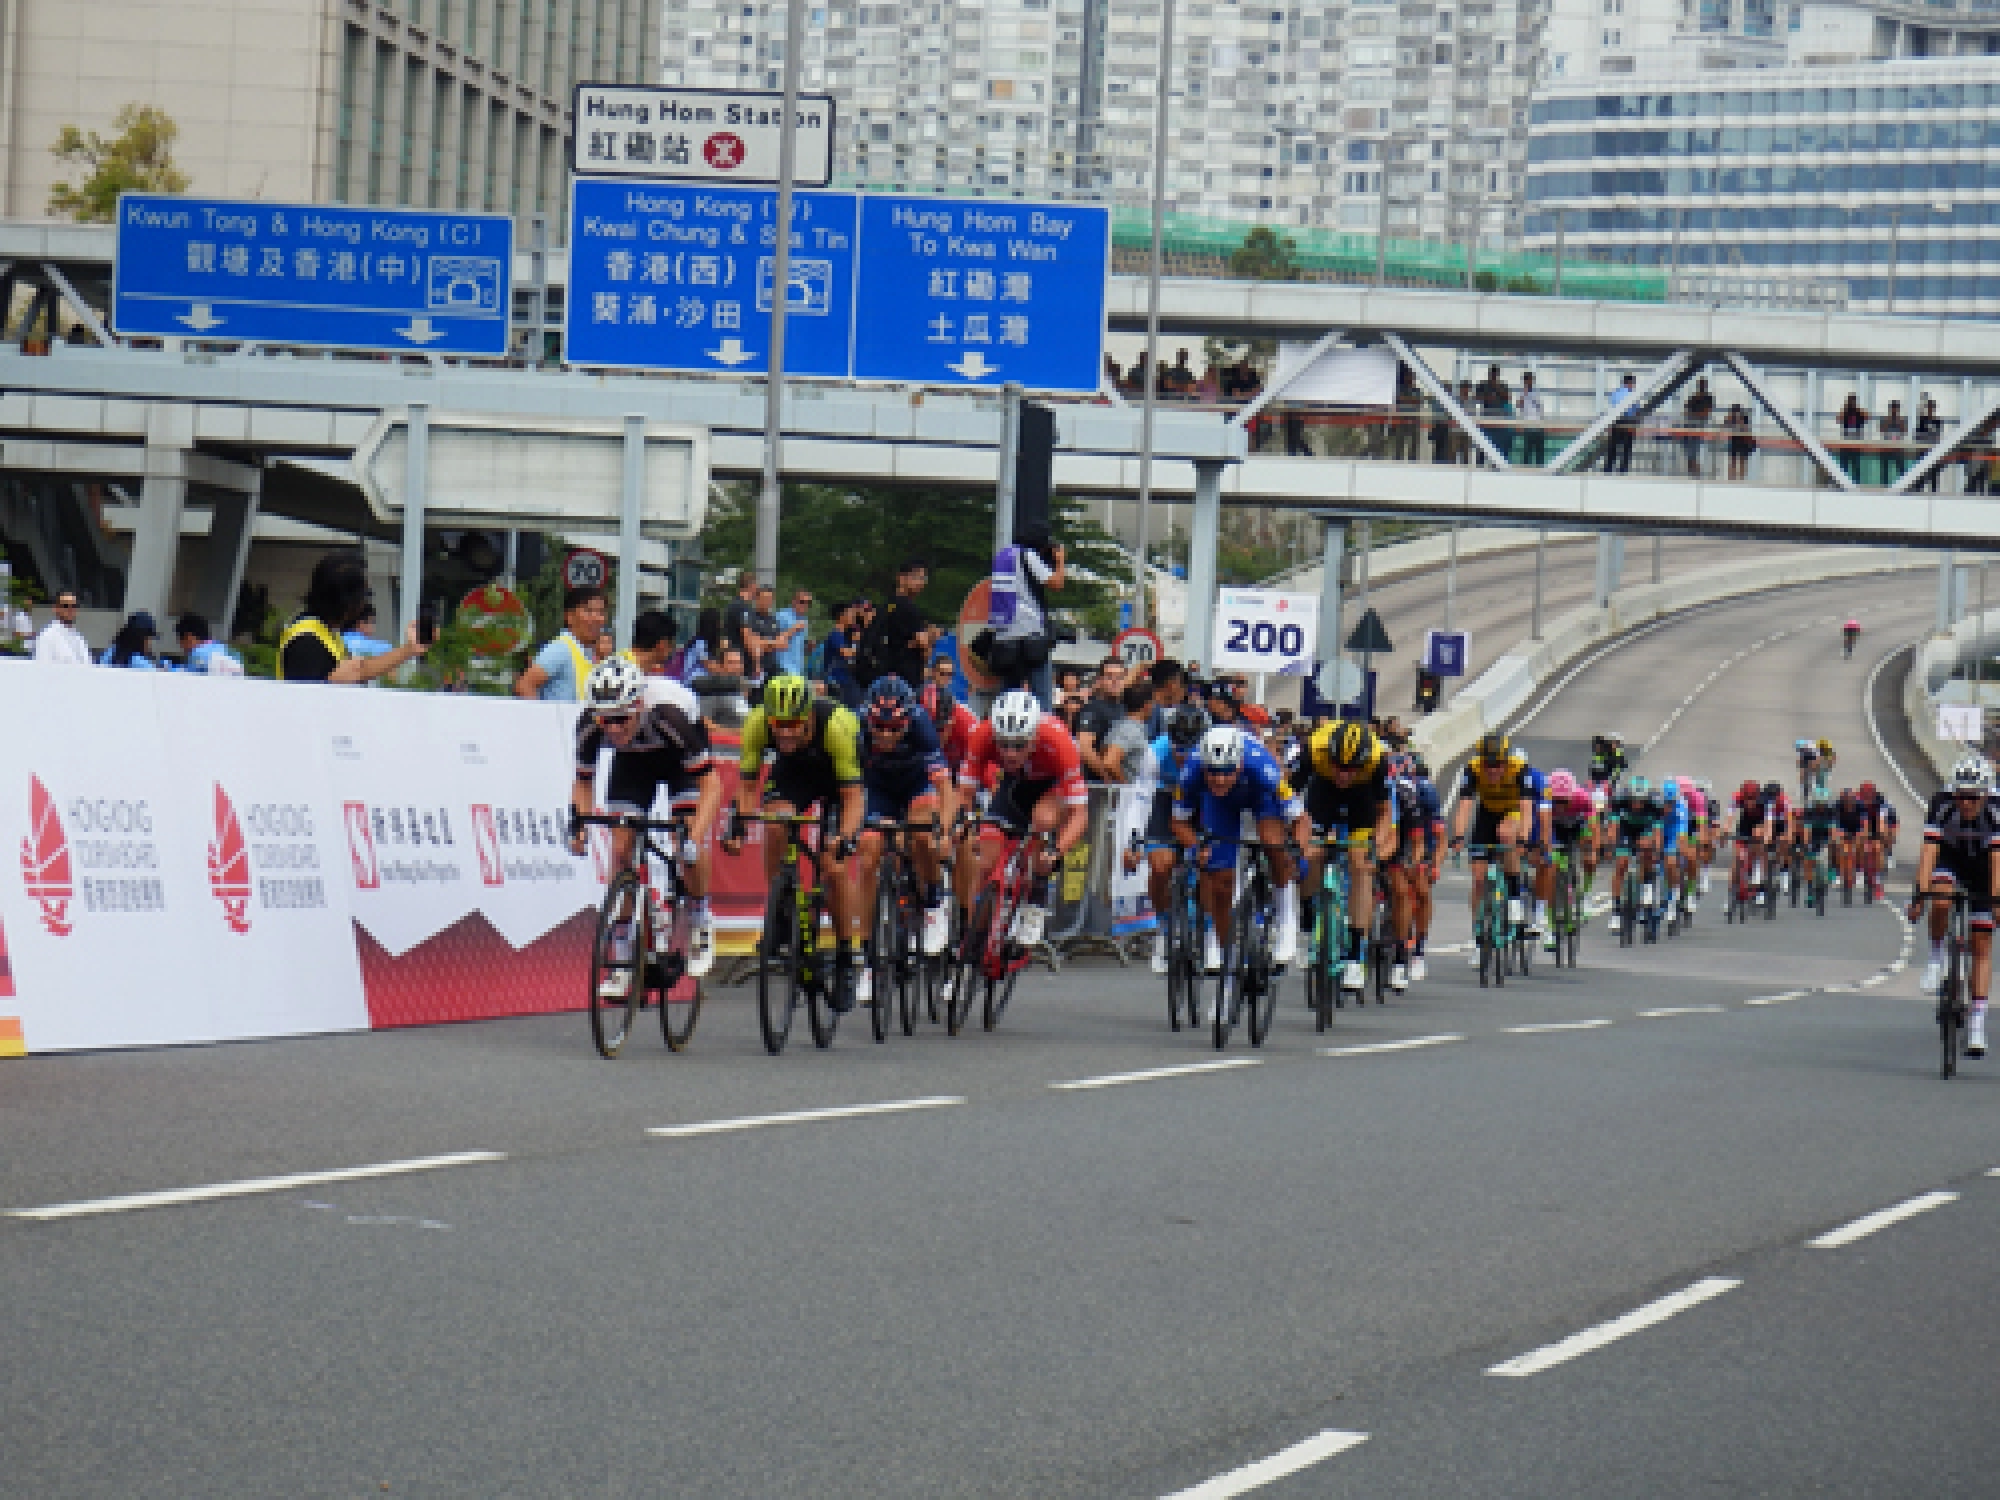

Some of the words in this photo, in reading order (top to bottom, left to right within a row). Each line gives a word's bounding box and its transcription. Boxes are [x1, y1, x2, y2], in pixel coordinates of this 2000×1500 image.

[587, 96, 649, 124] Hung
[660, 100, 716, 121] Hom
[724, 104, 821, 128] Staton
[626, 192, 685, 219] Hong
[695, 196, 753, 222] Kong
[892, 204, 952, 232] Hung
[964, 208, 1016, 233] Hom
[1029, 212, 1075, 239] Bay
[127, 206, 190, 228] Kwun
[203, 208, 257, 236] Tong
[272, 213, 288, 234] &
[303, 216, 361, 243] Hong
[372, 220, 429, 247] Kong
[439, 223, 481, 245] (C)
[584, 215, 638, 238] Kwai
[648, 220, 721, 247] Chung
[729, 224, 747, 244] &
[760, 224, 804, 248] Sa
[812, 227, 848, 250] Tin
[909, 232, 940, 257] To
[947, 236, 996, 257] Kwa
[1008, 240, 1057, 261] Wan
[605, 250, 737, 287] 香港(西)
[570, 562, 602, 585] 70
[1123, 643, 1154, 664] 70
[1226, 619, 1303, 657] 200
